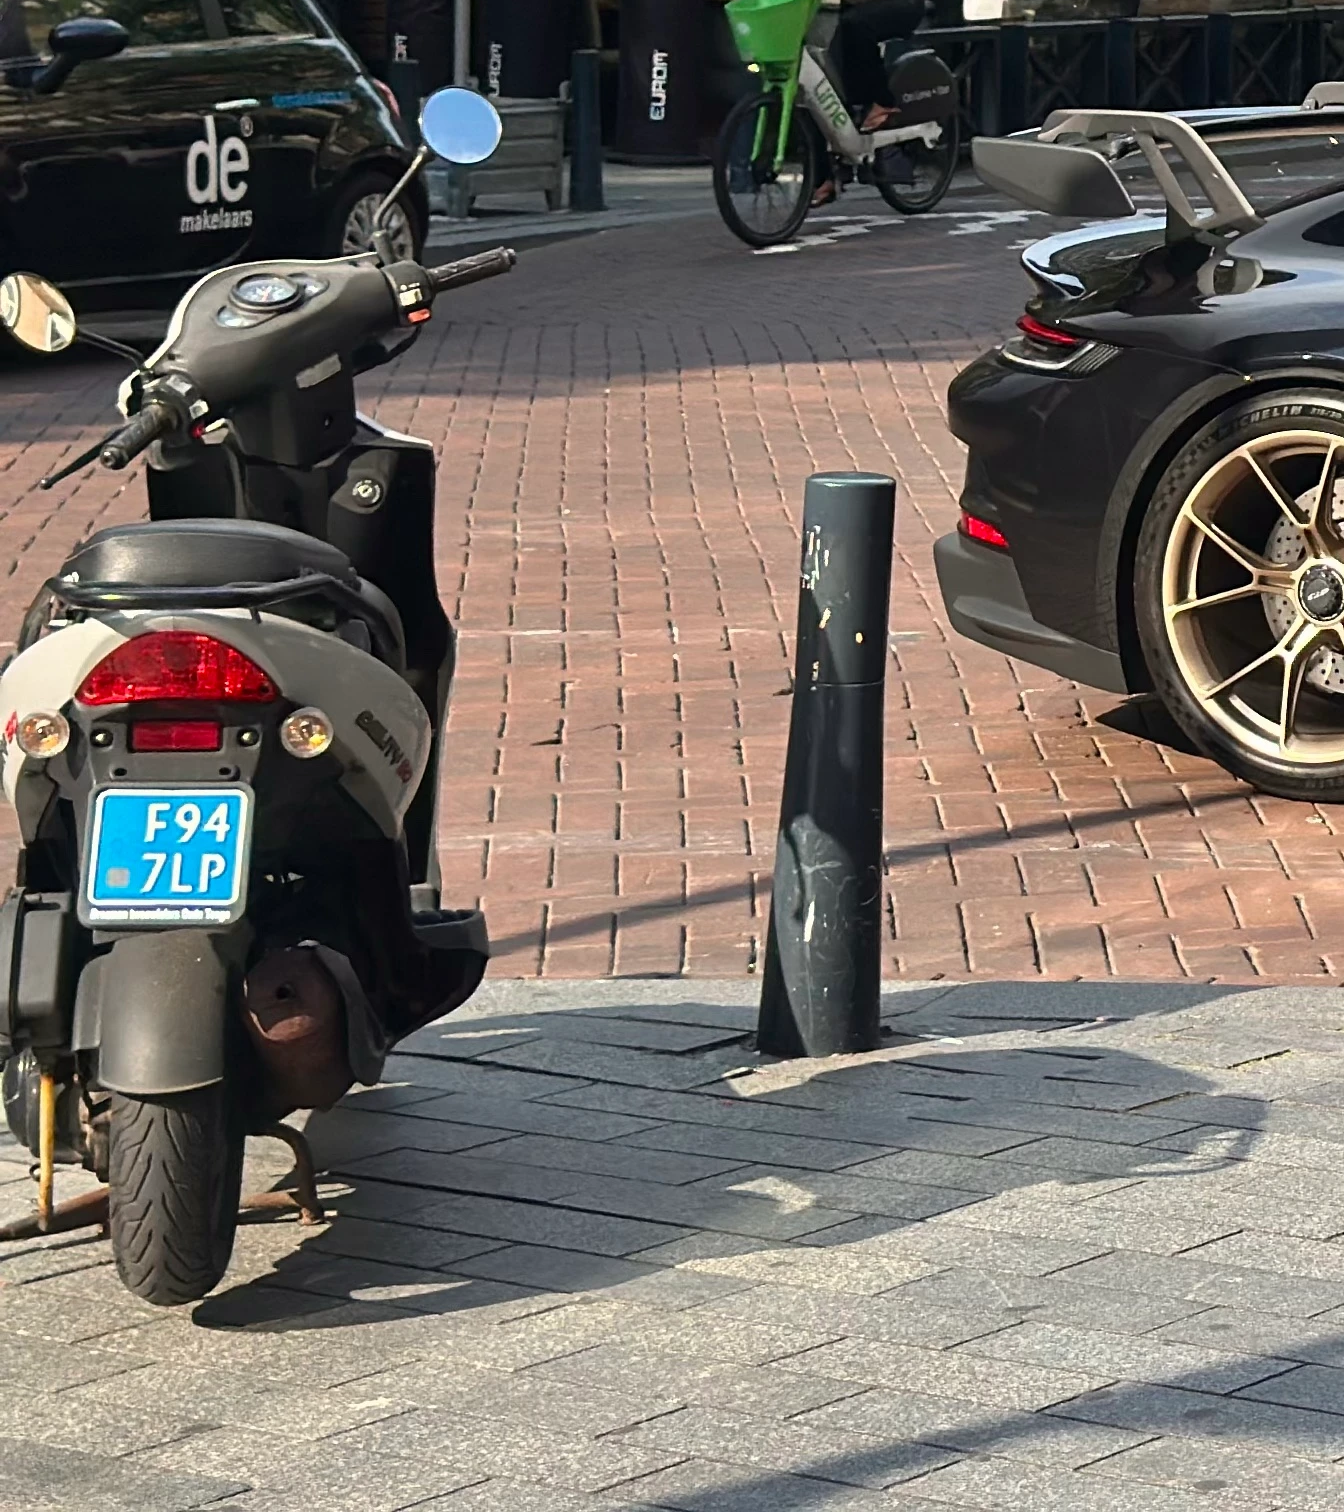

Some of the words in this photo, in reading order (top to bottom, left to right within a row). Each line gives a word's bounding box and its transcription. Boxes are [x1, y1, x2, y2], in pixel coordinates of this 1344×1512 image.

[186, 114, 250, 204] de
[180, 208, 253, 234] makelaars
[1222, 404, 1303, 436] ICHELIN
[143, 802, 231, 843] F94
[139, 852, 227, 894] 7LP
